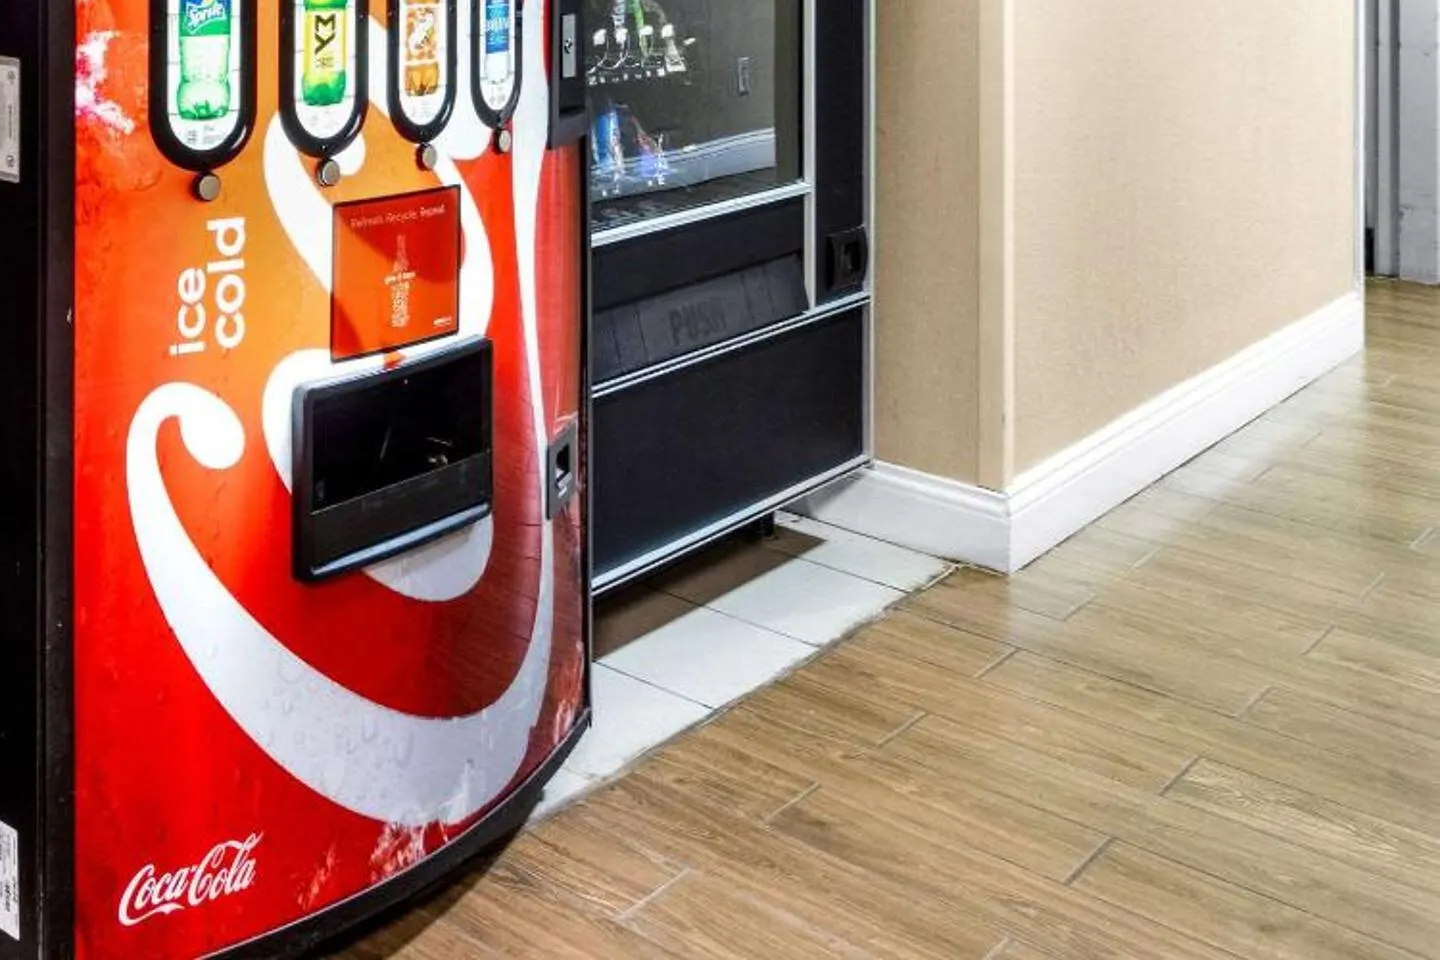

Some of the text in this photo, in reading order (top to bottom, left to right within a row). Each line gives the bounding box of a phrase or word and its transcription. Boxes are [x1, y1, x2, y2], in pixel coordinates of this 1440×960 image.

[169, 267, 206, 356] ice
[206, 216, 246, 349] cold
[118, 831, 264, 926] Coca-Cola
